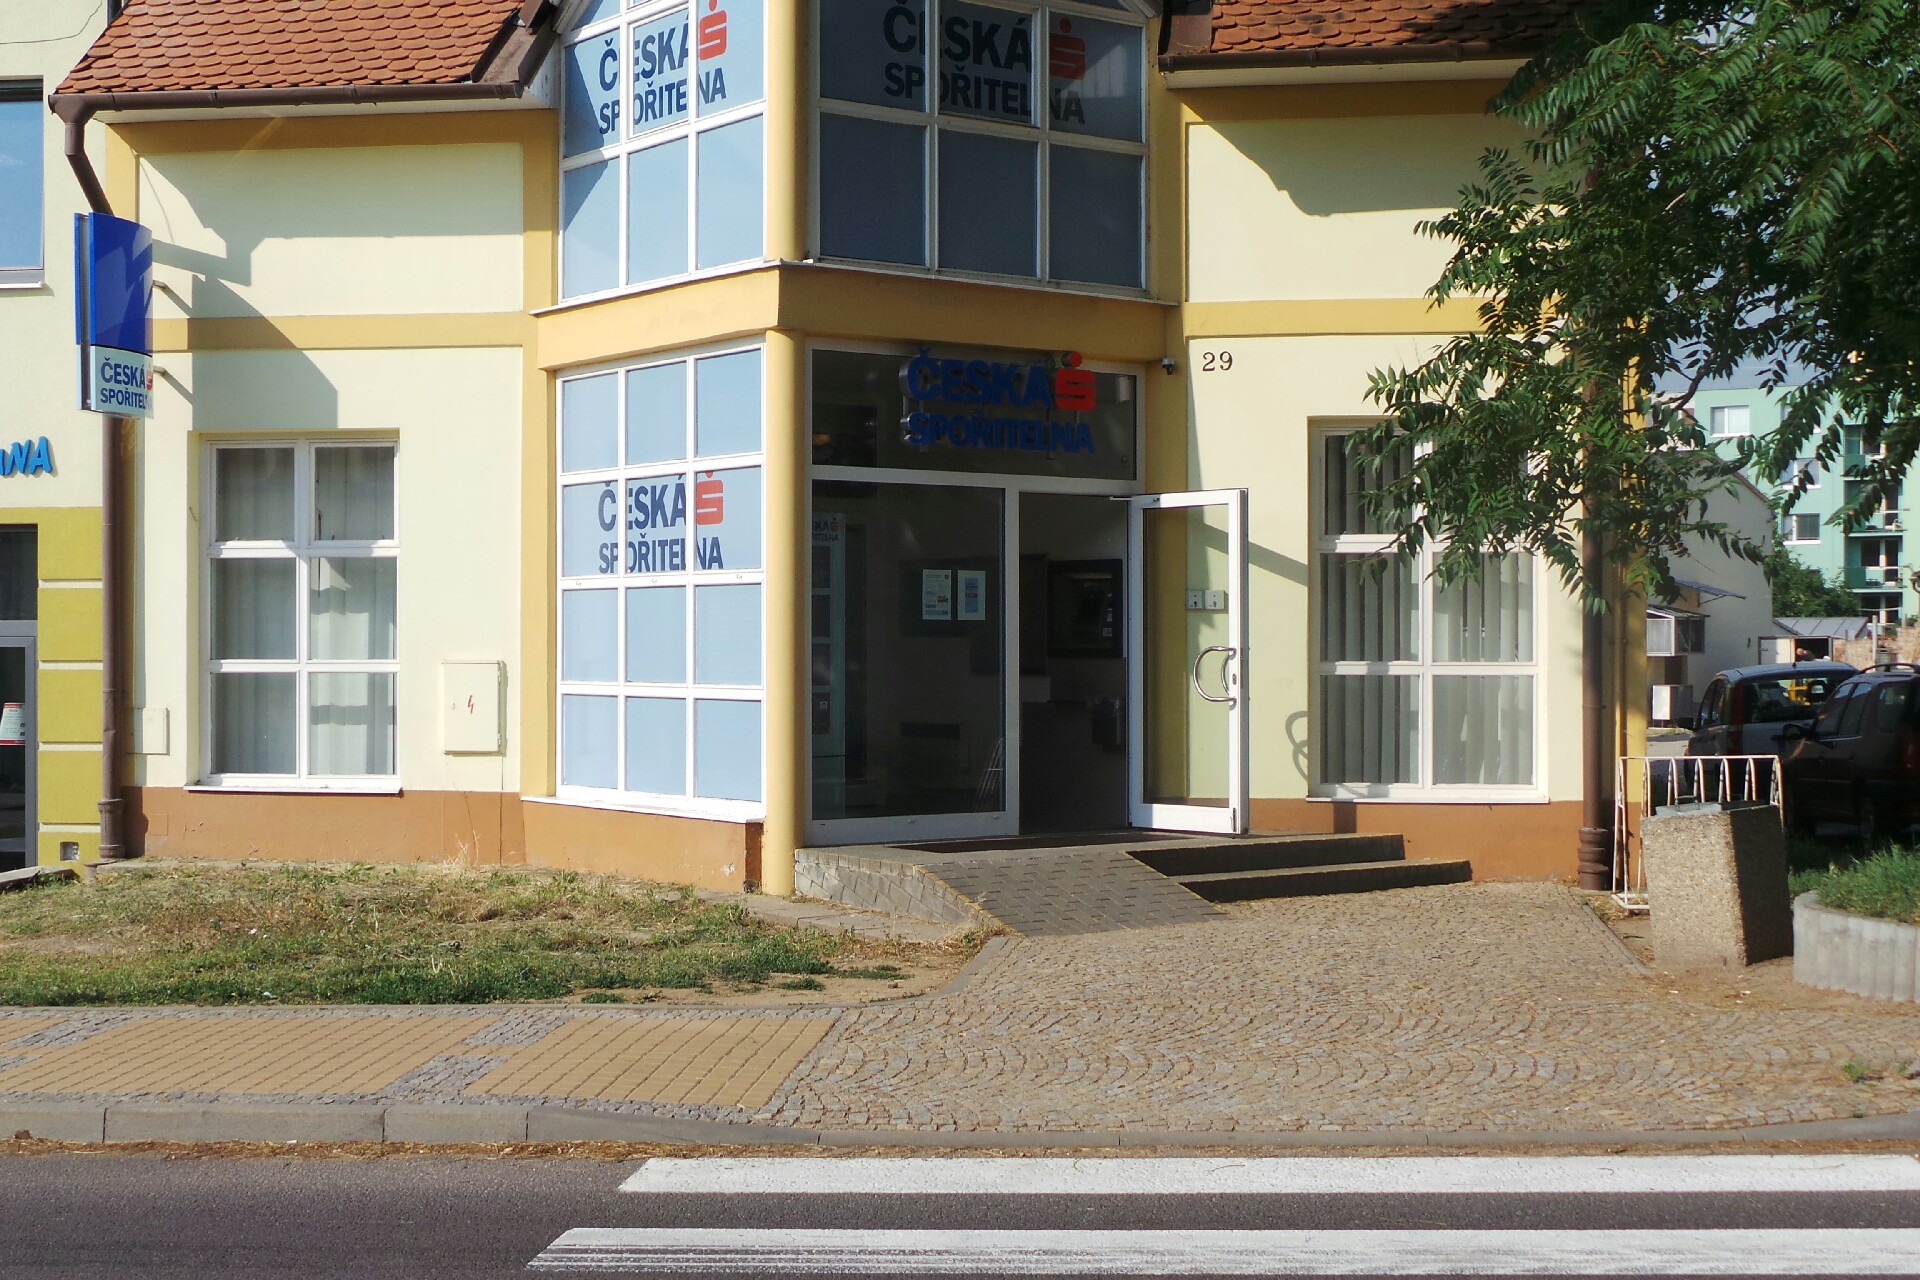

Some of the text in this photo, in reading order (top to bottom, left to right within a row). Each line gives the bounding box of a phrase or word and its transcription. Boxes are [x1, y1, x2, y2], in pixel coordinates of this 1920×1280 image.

[599, 67, 727, 135] SPOŘITENA
[101, 356, 146, 389] ČESKÁ
[907, 346, 1055, 409] ČESKÁ
[1202, 351, 1233, 371] 29
[100, 387, 152, 411] SPOŘITEL
[907, 409, 1095, 454] SPOŘITELNA
[0, 435, 53, 476] NA
